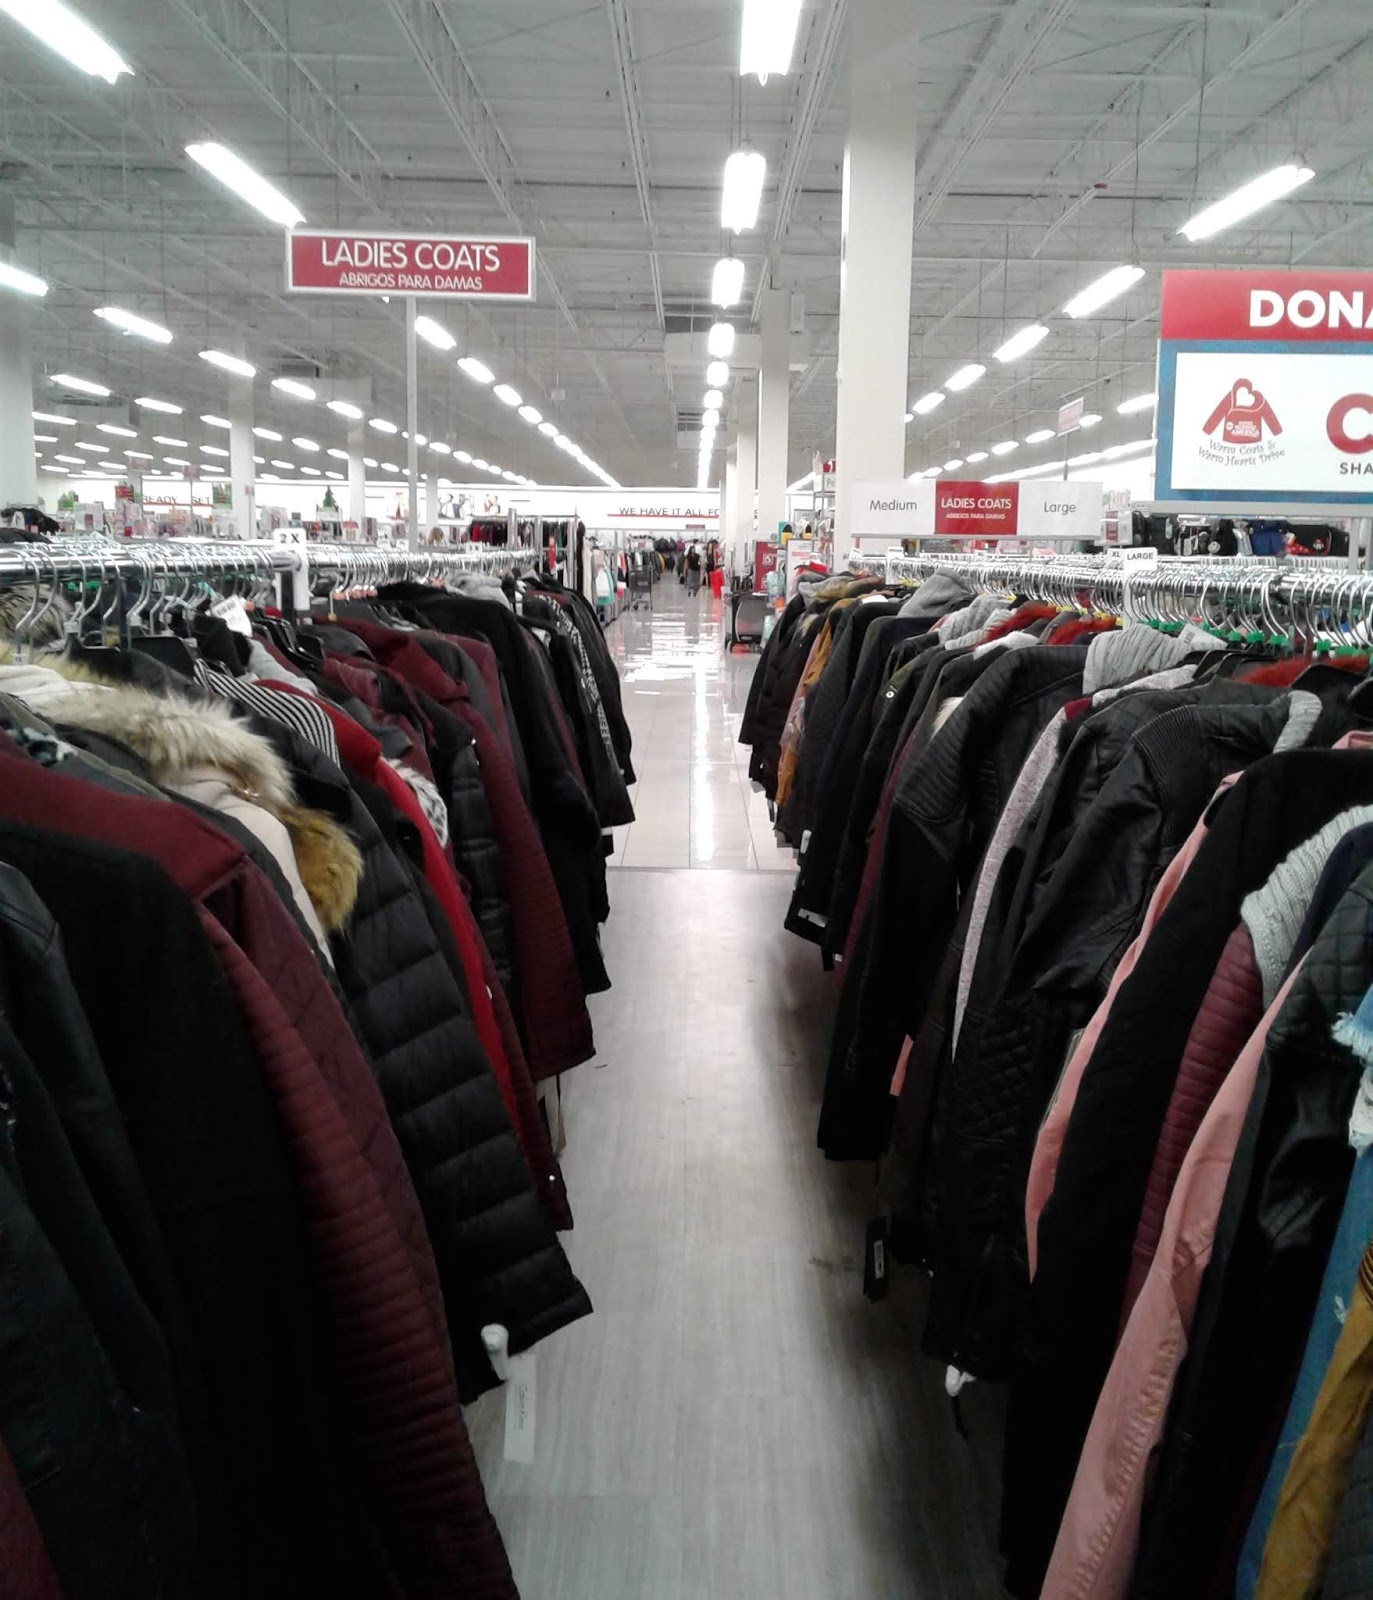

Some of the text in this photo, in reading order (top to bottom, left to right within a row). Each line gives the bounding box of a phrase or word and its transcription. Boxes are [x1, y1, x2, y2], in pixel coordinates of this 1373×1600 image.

[322, 239, 500, 272] LADIES COATS
[339, 272, 483, 291] ABRIGOS PARA DAMAS
[1209, 439, 1236, 454] Warm
[1239, 444, 1264, 455] Coats
[1198, 446, 1286, 467] Warm Hearts Drive
[869, 500, 918, 511] Medium
[941, 497, 1012, 509] LADIES COATS
[1043, 501, 1077, 516] Large
[619, 507, 636, 515] WE
[640, 507, 668, 515] HAVE
[672, 508, 681, 516] IT
[685, 508, 703, 516] ALL
[1127, 552, 1154, 561] LARGE
